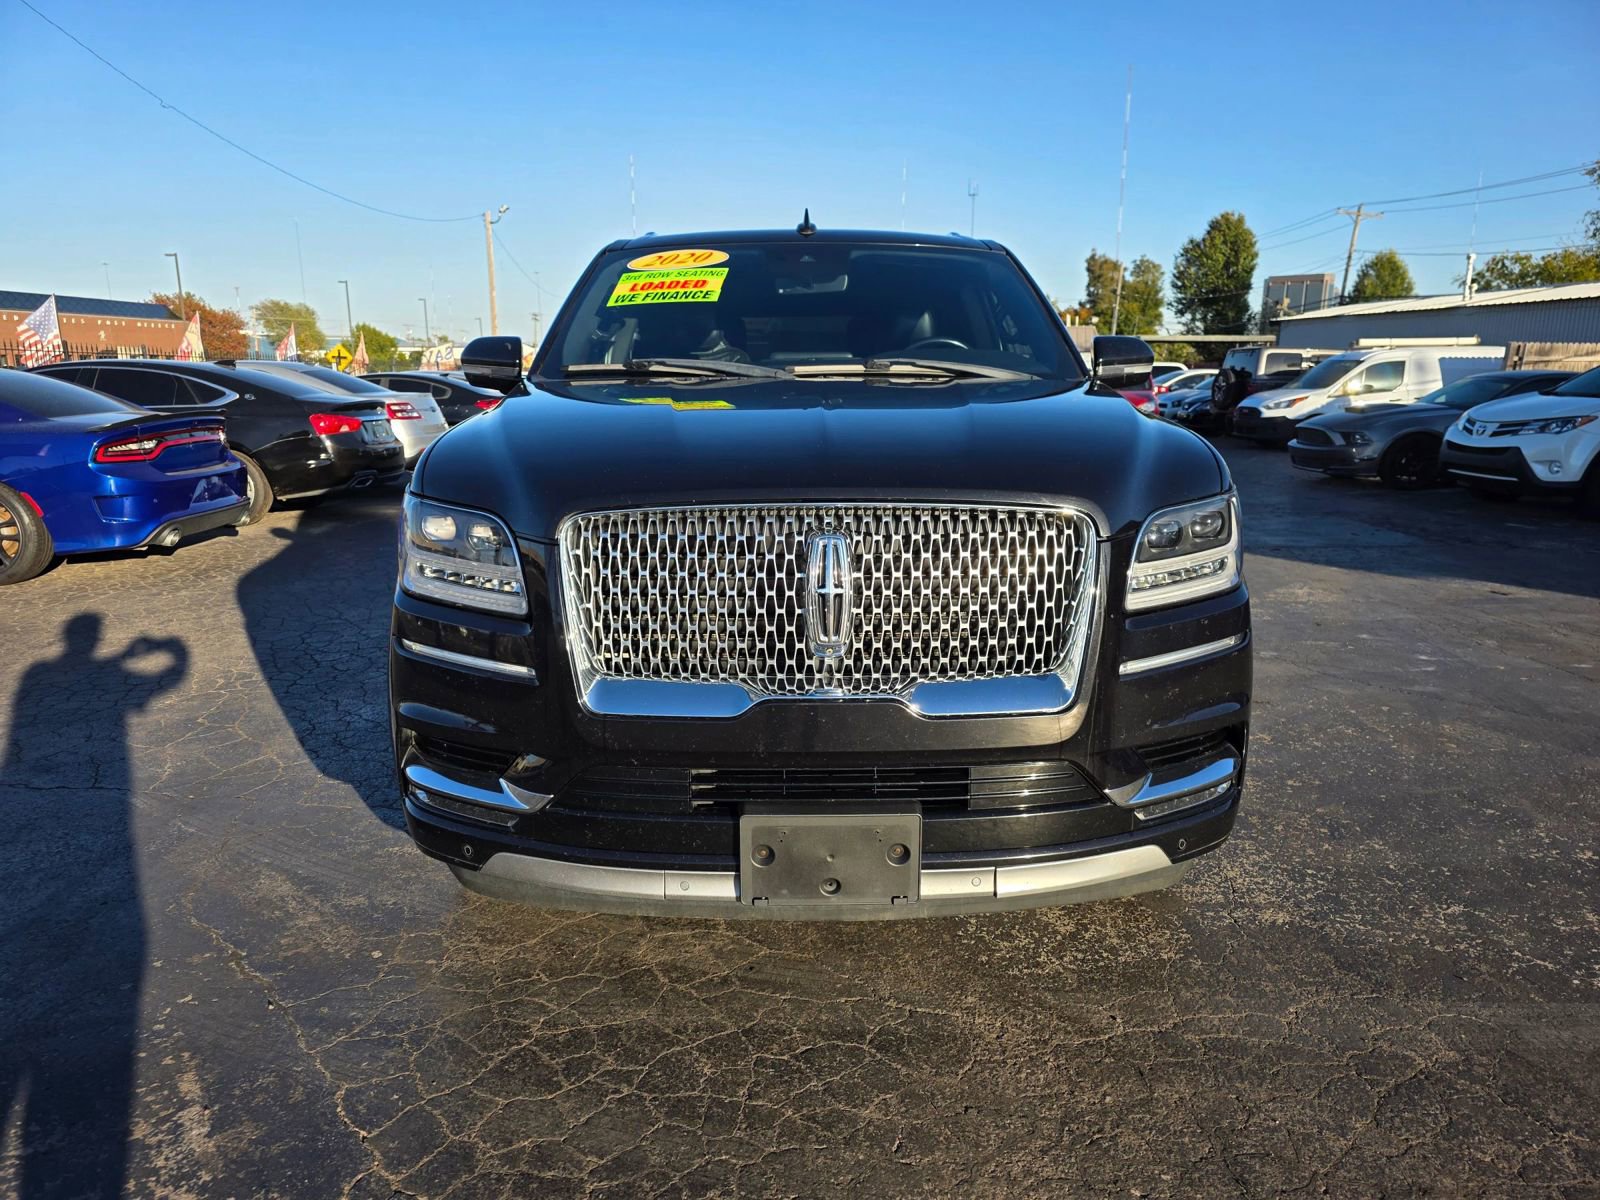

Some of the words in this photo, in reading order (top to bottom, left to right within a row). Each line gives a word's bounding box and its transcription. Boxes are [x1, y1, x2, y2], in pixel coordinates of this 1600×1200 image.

[642, 252, 713, 268] 2020
[622, 273, 642, 282] 3rd
[646, 271, 673, 279] ROW
[675, 269, 725, 278] SEATING
[629, 279, 708, 292] LOADED
[614, 293, 641, 304] WE
[642, 290, 713, 302] FINANCE
